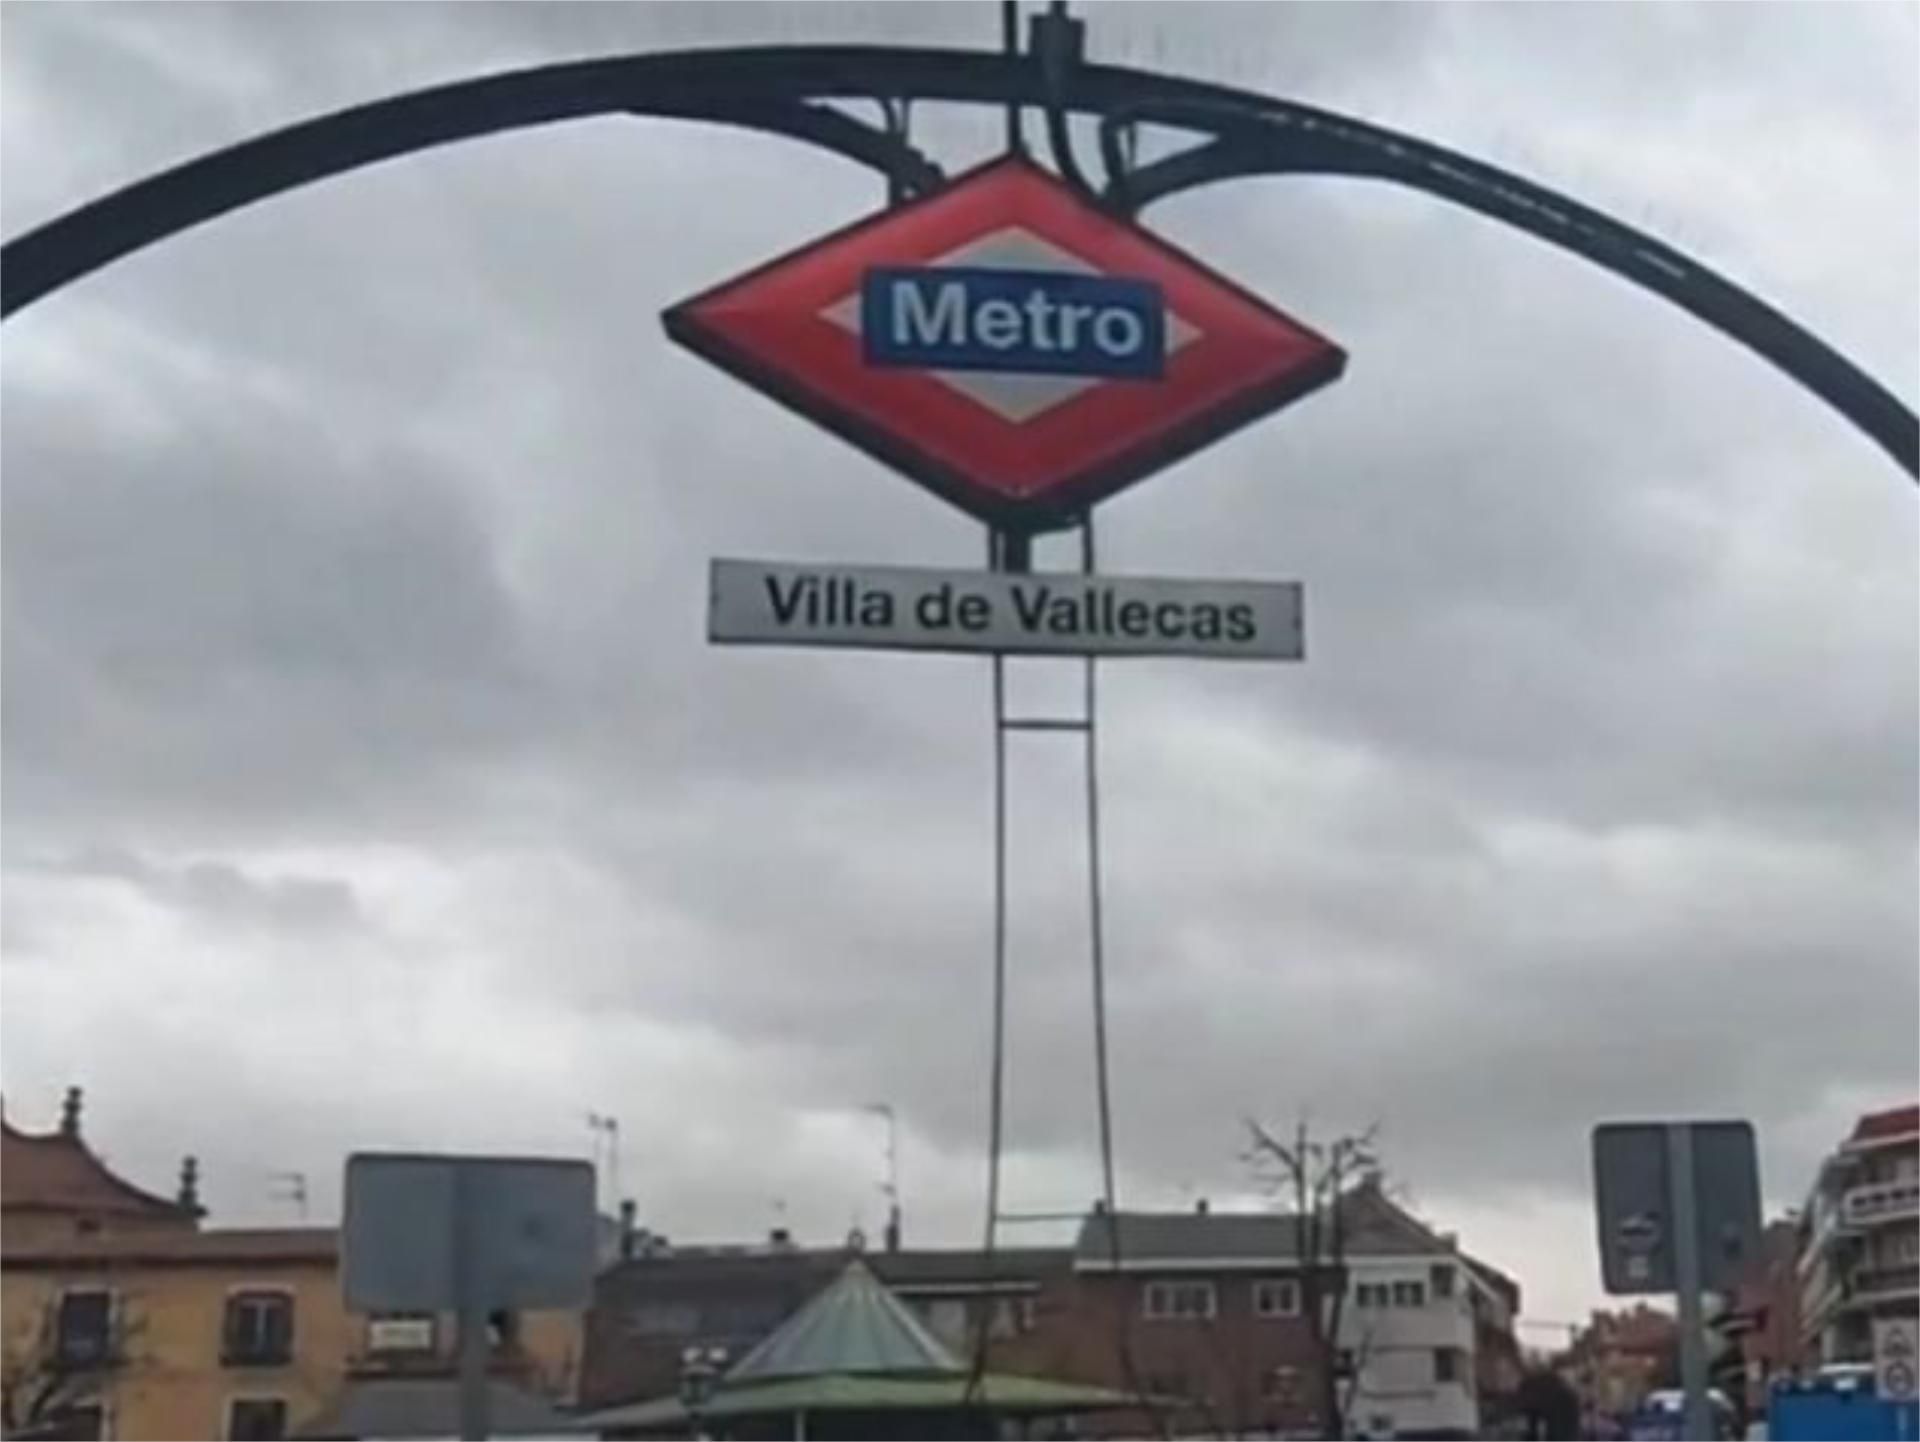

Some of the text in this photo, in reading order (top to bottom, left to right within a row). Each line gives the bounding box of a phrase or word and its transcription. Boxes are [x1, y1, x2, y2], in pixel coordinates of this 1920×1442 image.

[891, 279, 1142, 356] Metro
[765, 574, 1257, 642] Villa de Vallecas
